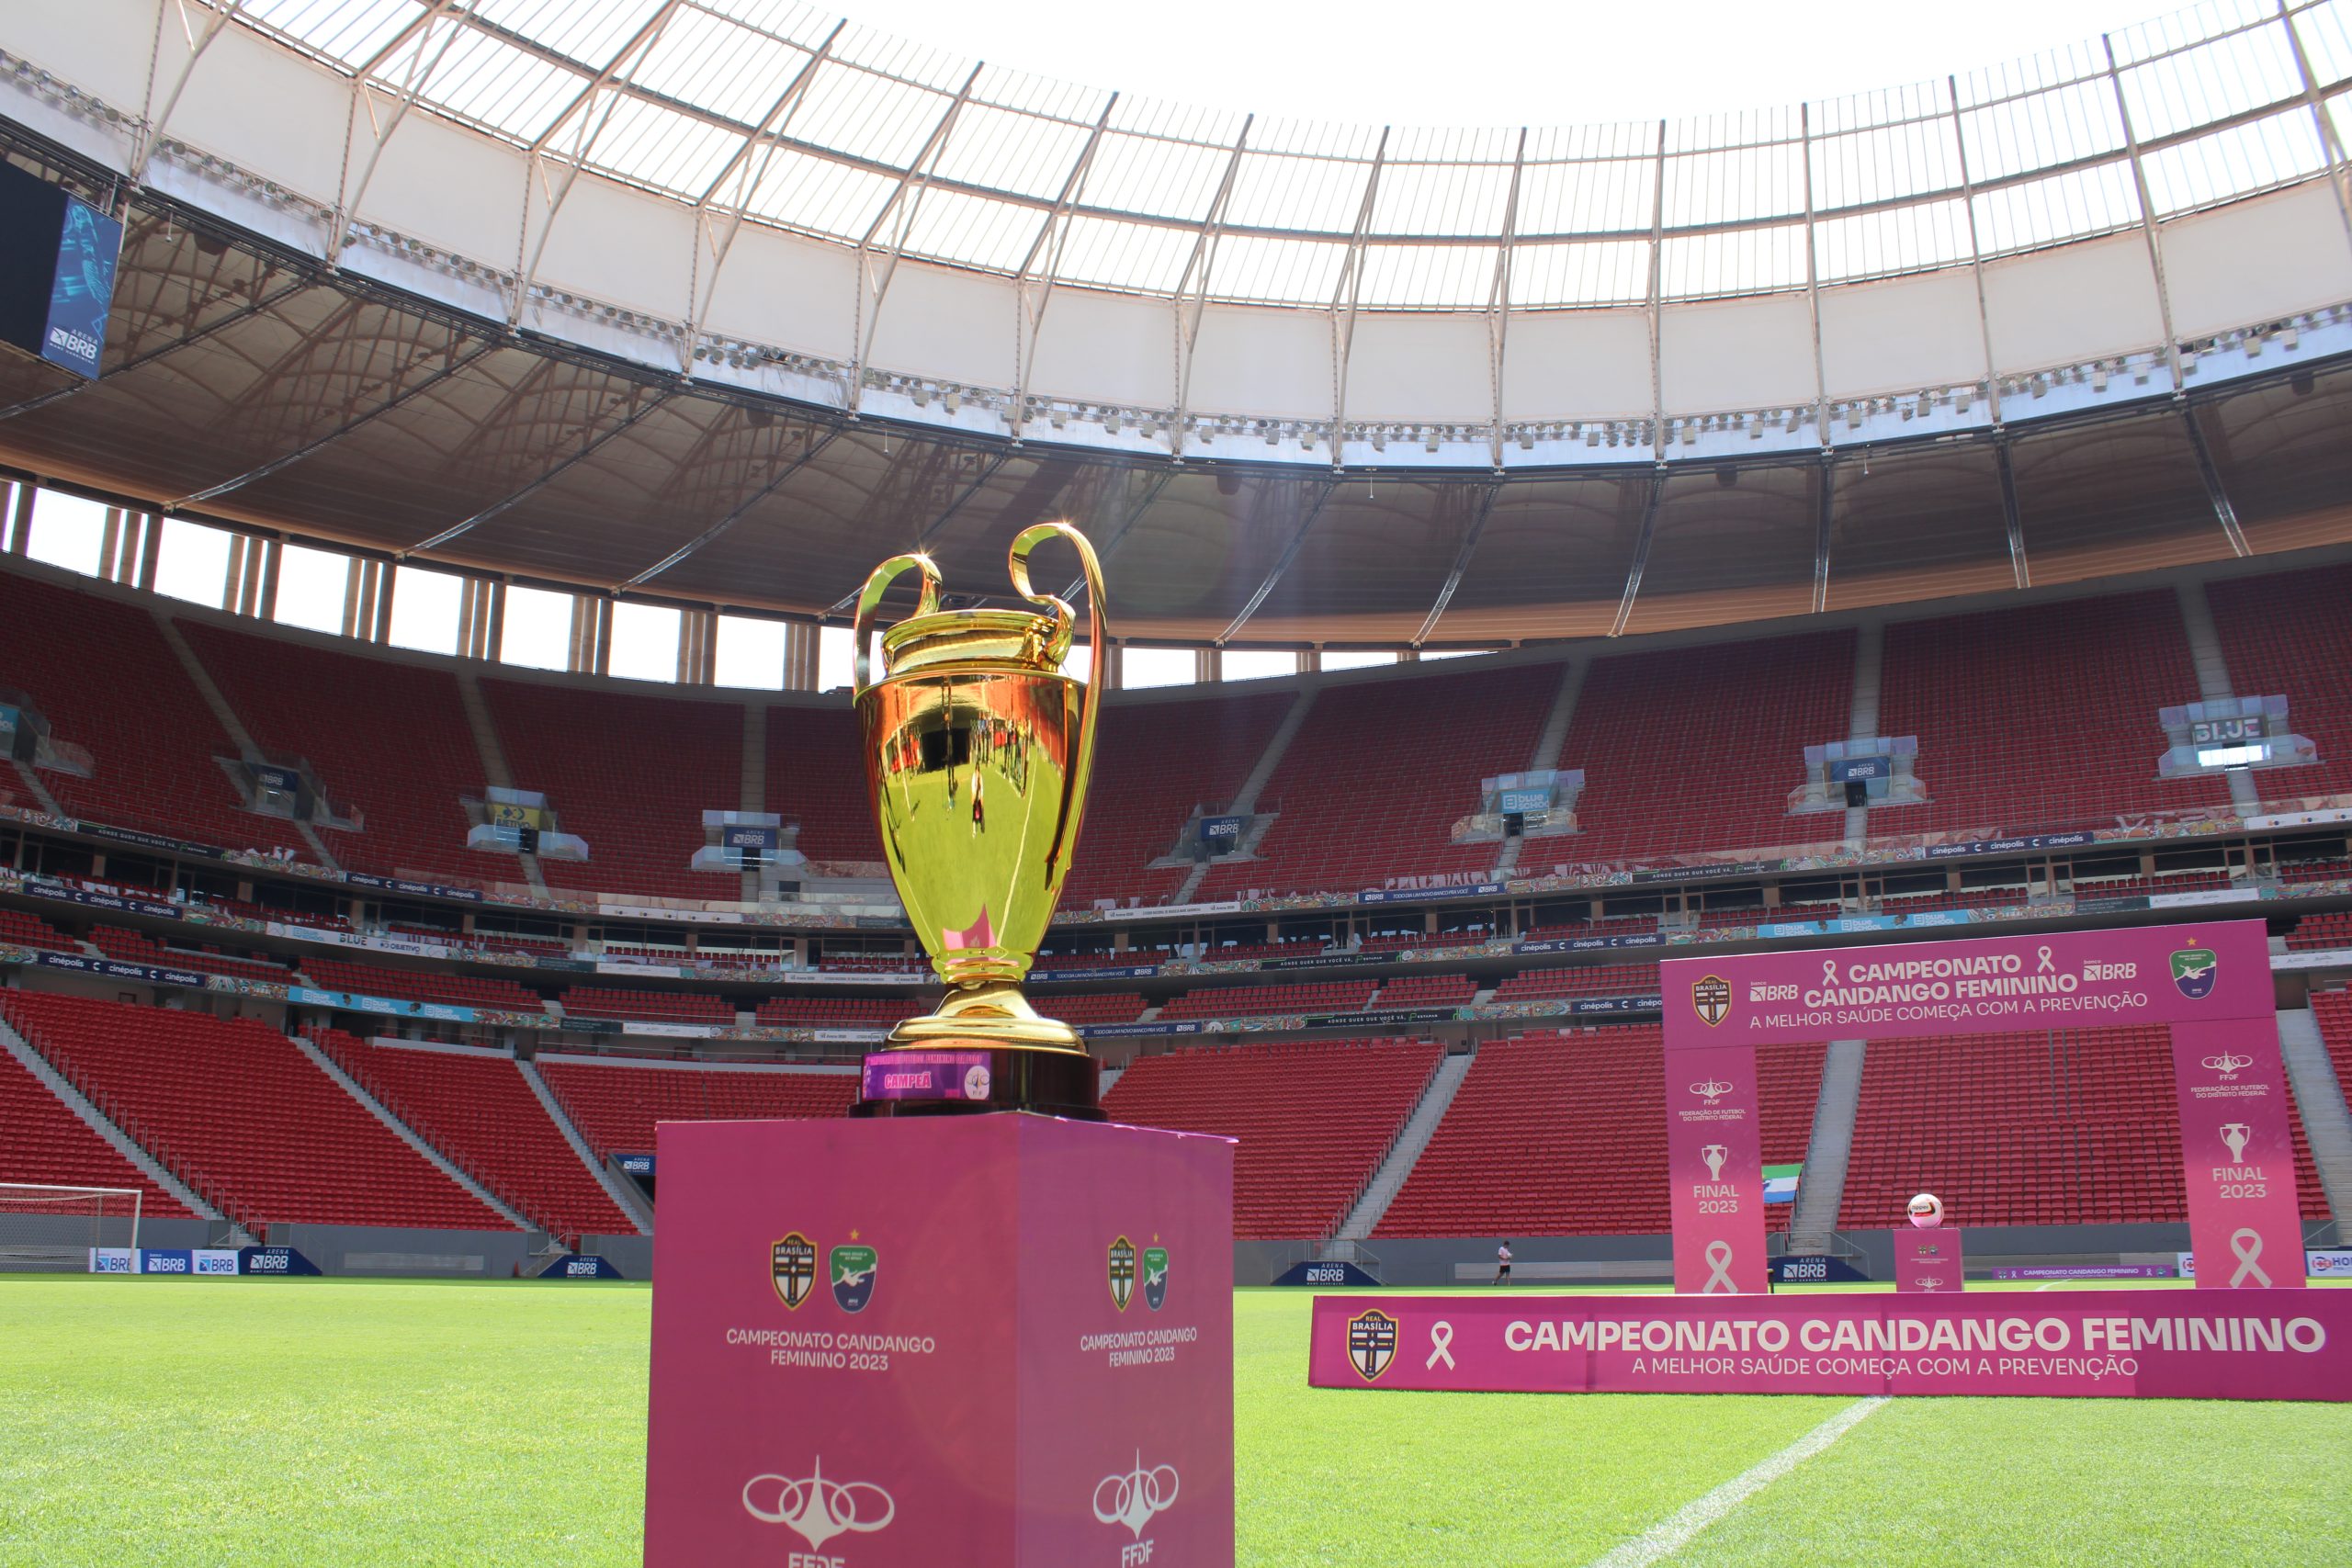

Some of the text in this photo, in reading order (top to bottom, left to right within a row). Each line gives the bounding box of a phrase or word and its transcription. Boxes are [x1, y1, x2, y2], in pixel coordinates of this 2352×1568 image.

[71, 328, 98, 345] ARENA
[66, 334, 97, 359] BRB
[2194, 718, 2260, 742] BLUE
[1857, 766, 1875, 776] BRB
[743, 835, 764, 845] BRB
[1932, 835, 2084, 855] cinépolis cinépolis cinépolis
[352, 875, 475, 899] cinépolis cinépolis cinépolis
[33, 886, 175, 916] cinépolis cinépolis cinépolis
[339, 933, 368, 946] BLUE
[390, 942, 421, 953] OBJETIVO
[1521, 936, 1657, 952] cinépolis cinépolis cinépolis
[49, 955, 197, 984] cinépolis cinépolis cinépolis
[1849, 953, 2022, 983] CAMPEONATO
[2101, 963, 2137, 980] BRB
[1695, 984, 1727, 992] BRASÍLIA
[1767, 985, 1798, 1001] BRB
[1804, 973, 2078, 1009] CANDANGO FEMININO
[1580, 998, 1662, 1010] cinépolis cinépo
[1749, 991, 2148, 1029] A MELHOR SAÚDE COMEÇA COM A PREVENÇÃO
[884, 1071, 933, 1089] CAMPEÃ
[2190, 1084, 2230, 1093] FEDERAÇÃO
[632, 1161, 650, 1170] BRB
[2212, 1167, 2268, 1181] FINAL
[1693, 1184, 1739, 1199] FINAL
[2220, 1183, 2267, 1199] 2023
[1699, 1200, 1738, 1214] 2023
[775, 1246, 813, 1256] BRASÍLIA
[1110, 1249, 1134, 1258] BRASÍLIA
[162, 1258, 186, 1272] BRB
[211, 1259, 234, 1272] BRB
[264, 1255, 288, 1269] BRB
[577, 1262, 597, 1275] BRB
[1319, 1269, 1344, 1282] BRB
[1798, 1264, 1826, 1278] BRB
[1351, 1321, 1394, 1331] BRASÍLIA
[727, 1328, 935, 1354] CAMPEONATO CANDANGO
[1080, 1326, 1197, 1352] CAMPEONATO CANDANGO
[1504, 1316, 2326, 1353] CAMPEONATO CANDANGO FEMININO
[771, 1349, 888, 1371] FEMININO 2023
[1109, 1347, 1175, 1368] FEMININO 2023
[1632, 1353, 2139, 1381] A MELHOR SAÚDE COMEÇA COM A PREVENÇÃO
[1122, 1539, 1154, 1568] FFDF
